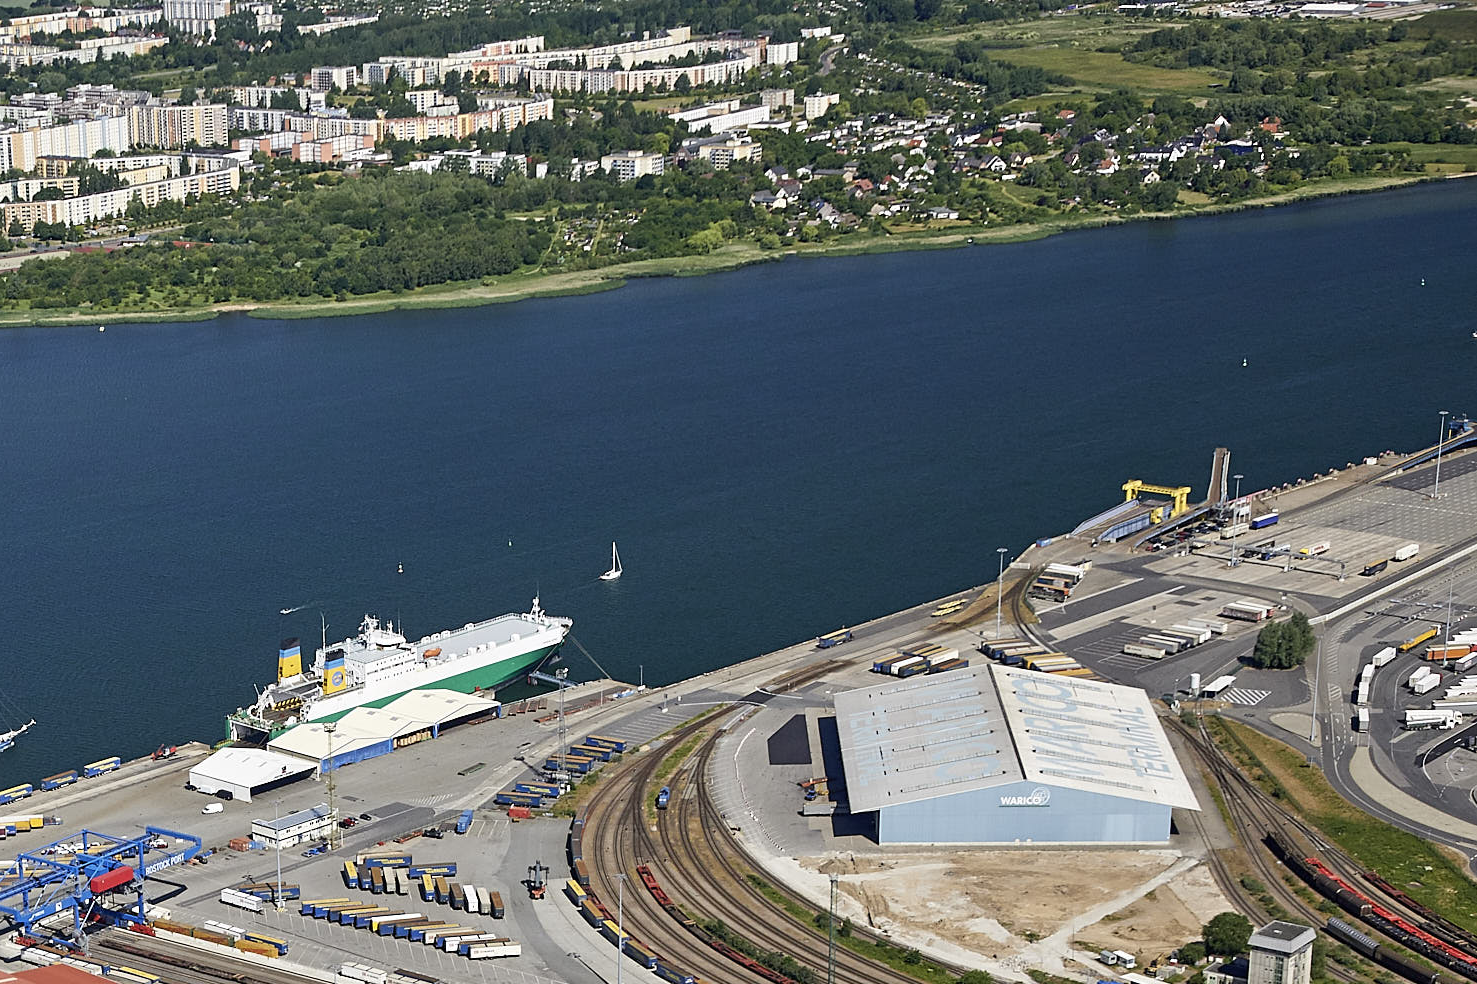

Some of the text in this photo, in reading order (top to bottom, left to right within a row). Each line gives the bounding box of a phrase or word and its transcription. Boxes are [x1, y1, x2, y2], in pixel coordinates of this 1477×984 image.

[1000, 796, 1040, 805] WARICO
[145, 853, 185, 876] ROSTOCK PORT
